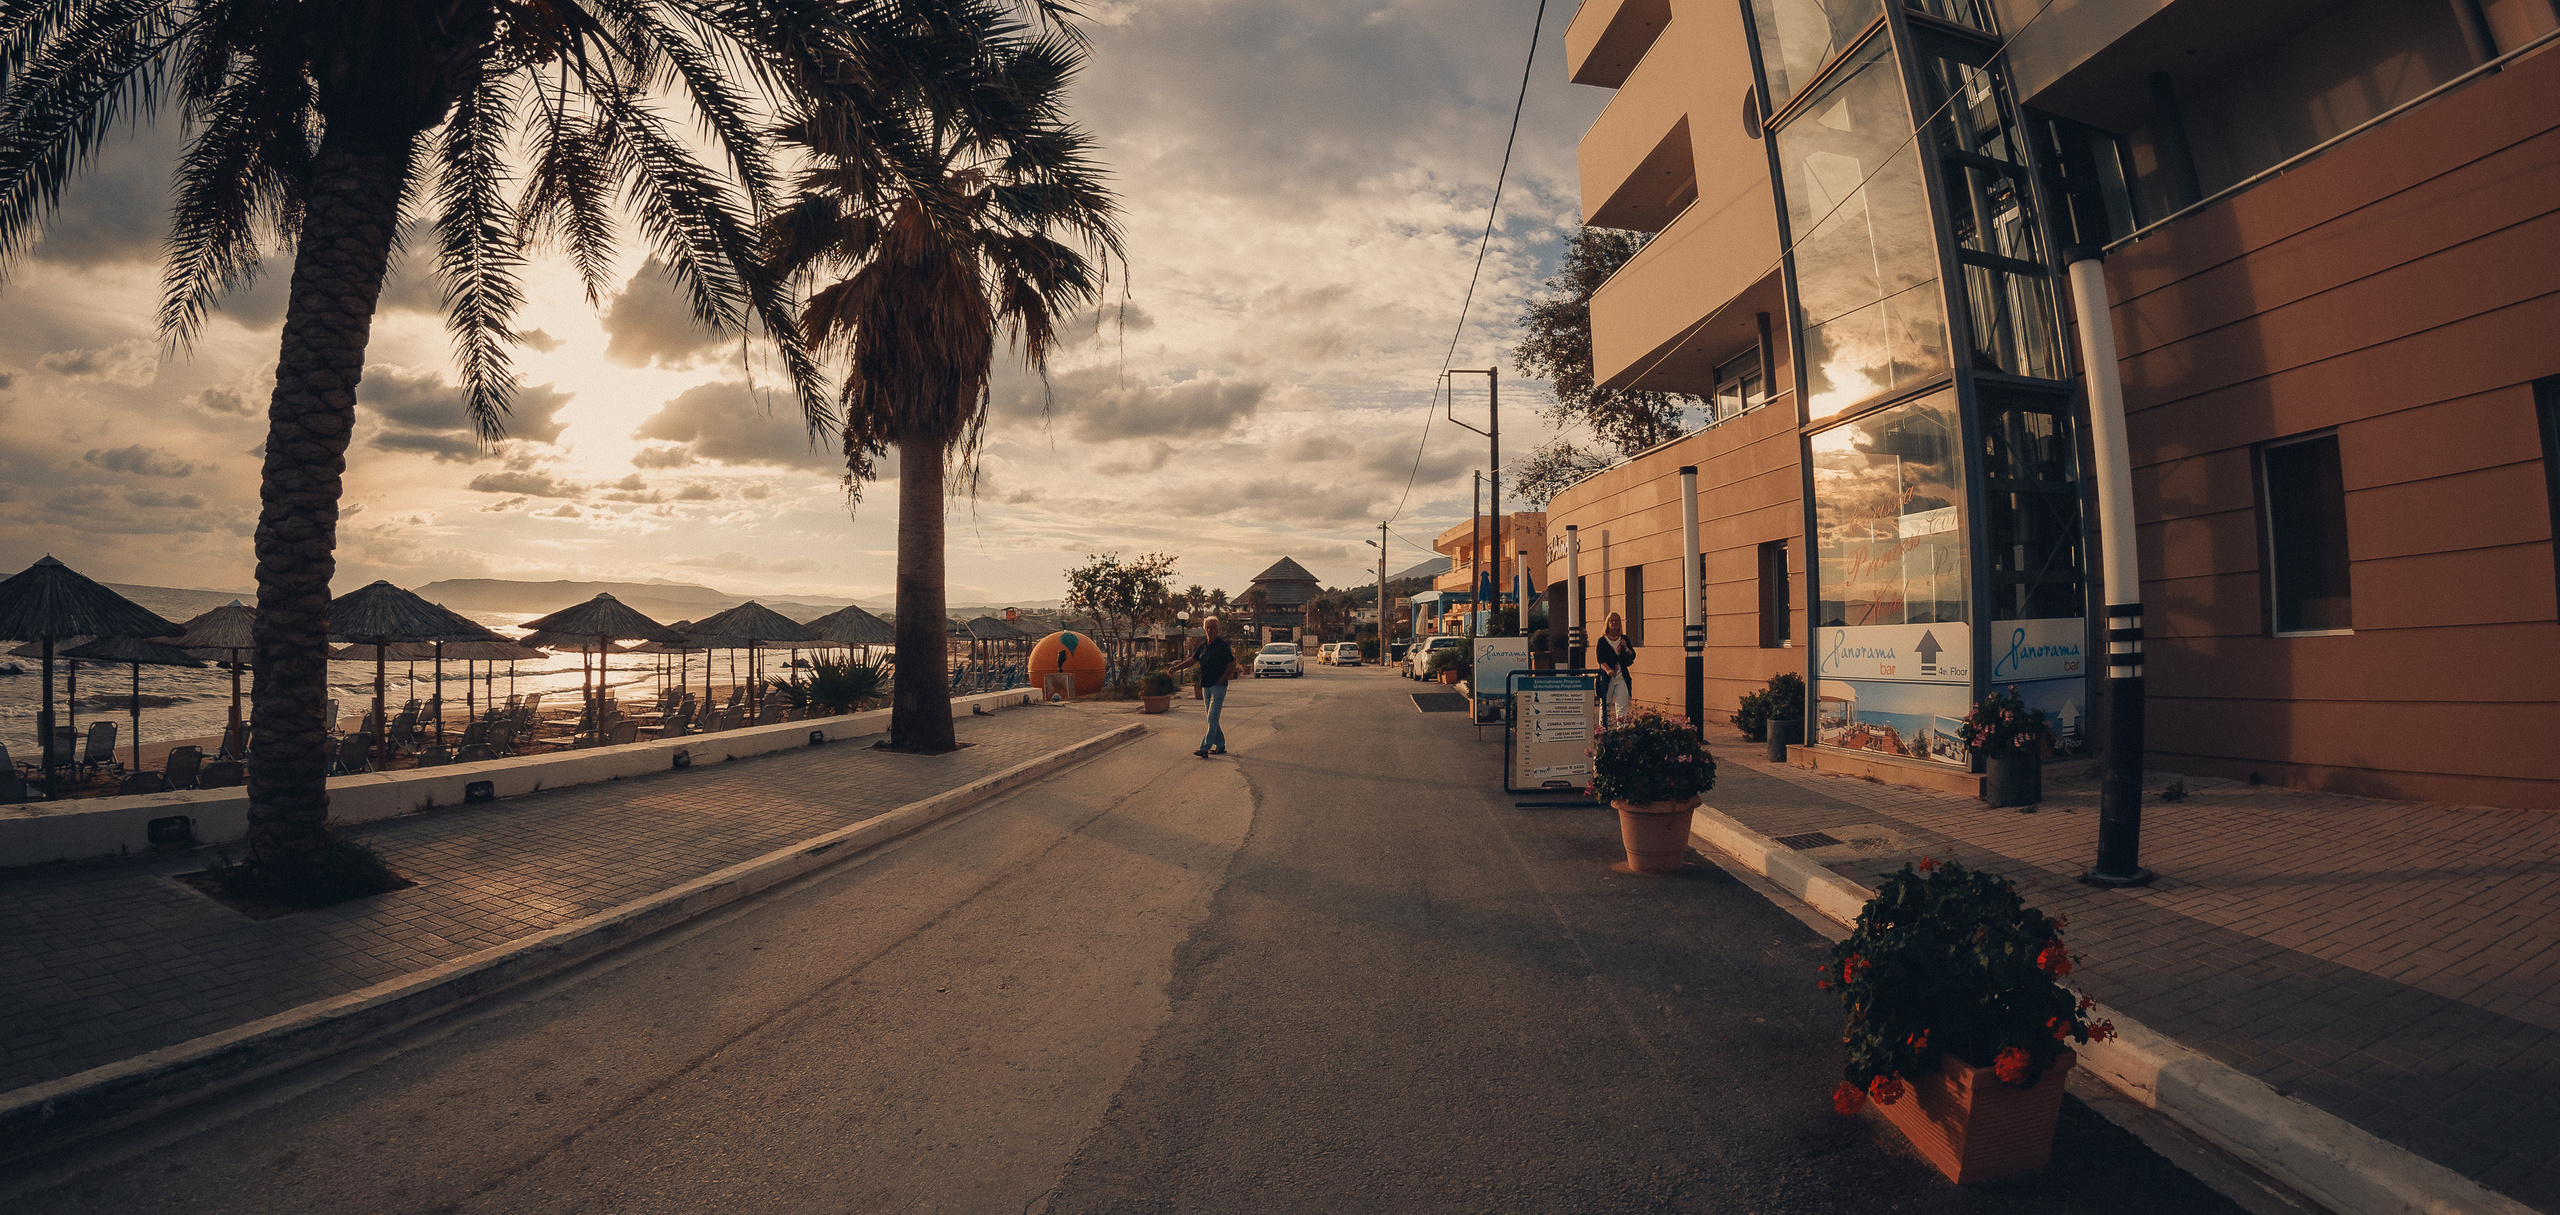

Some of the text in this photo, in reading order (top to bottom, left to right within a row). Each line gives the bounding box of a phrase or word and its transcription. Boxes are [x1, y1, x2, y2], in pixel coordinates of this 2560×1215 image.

[1846, 529, 1921, 587] Princess
[1862, 580, 1910, 618] Hotel
[1477, 644, 1527, 663] Panorama
[1821, 629, 1896, 673] Panorama
[1994, 627, 2080, 677] Panorama
[1880, 662, 1896, 676] bar
[1938, 667, 1968, 676] 4th Floor
[2064, 659, 2080, 672] bar
